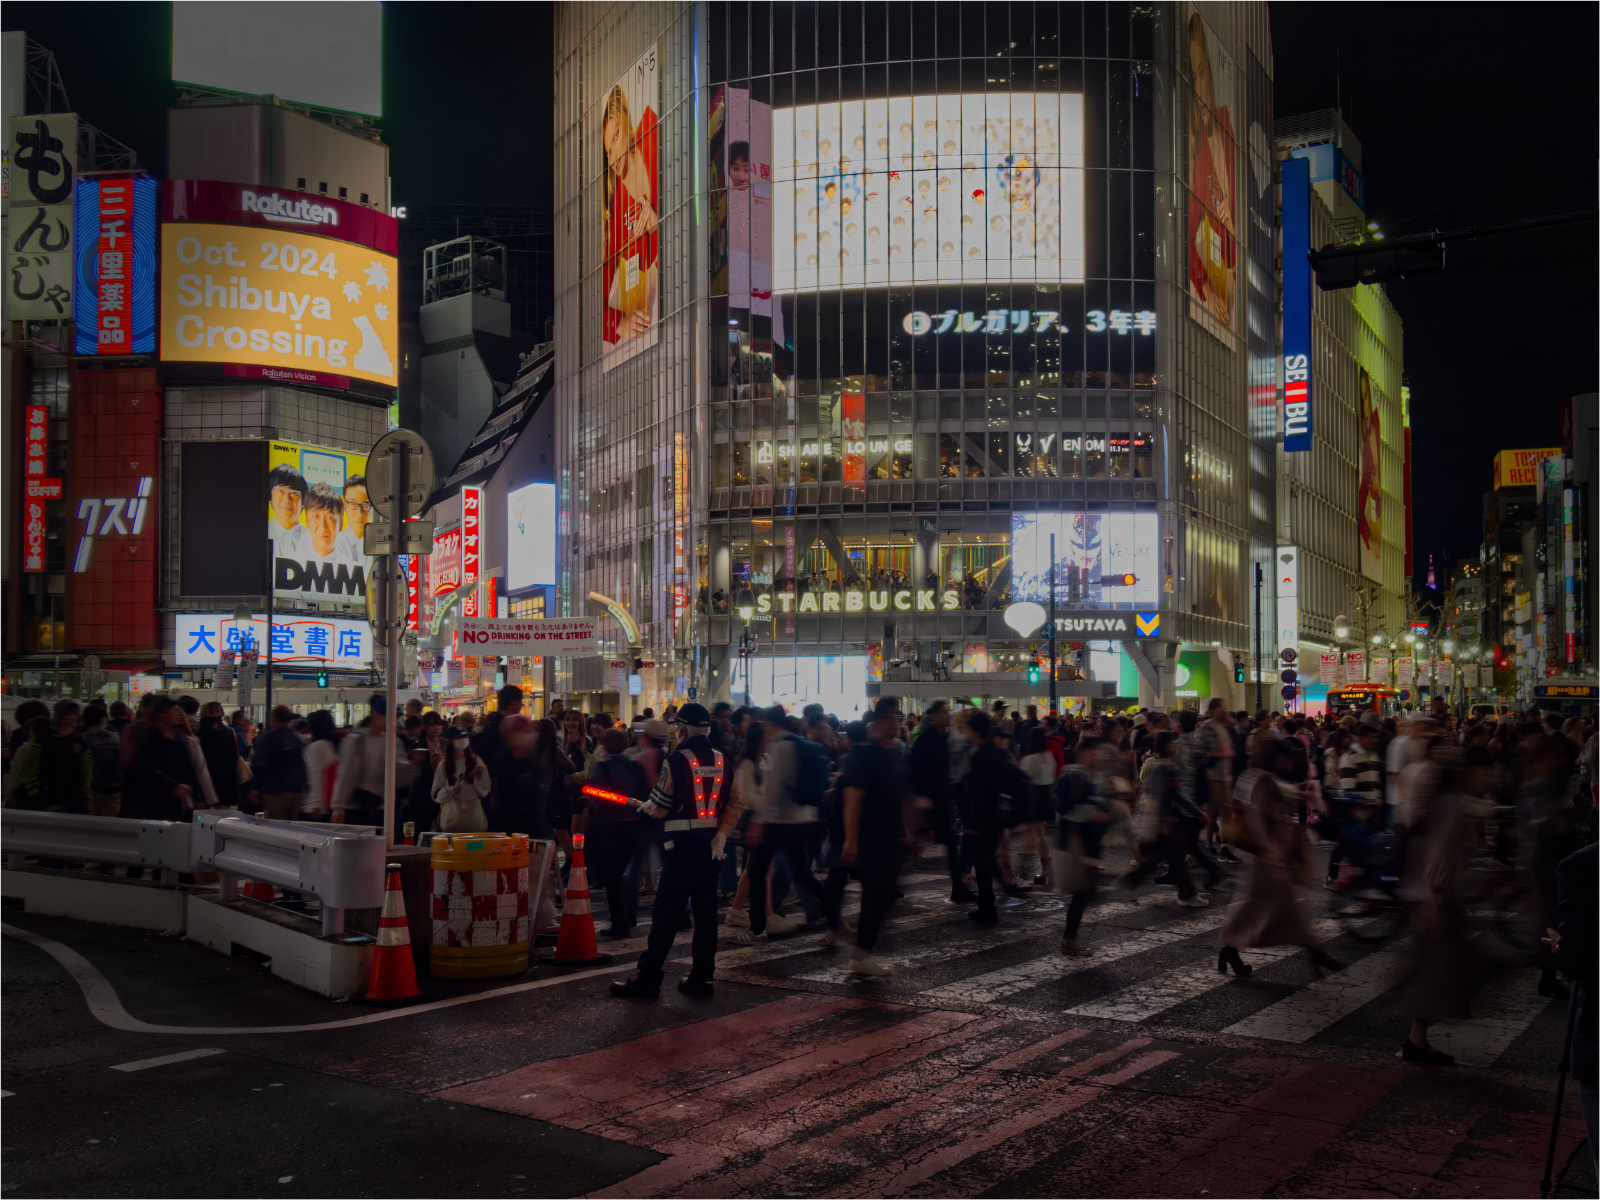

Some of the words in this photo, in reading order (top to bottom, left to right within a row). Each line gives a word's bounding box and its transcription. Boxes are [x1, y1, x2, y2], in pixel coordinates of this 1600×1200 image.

[14, 119, 73, 314] もんじゃ
[241, 190, 339, 226] Rakuten
[98, 186, 126, 344] 三千里薬品
[176, 236, 246, 268] Oct.
[260, 242, 338, 280] 2024
[176, 273, 332, 322] Shibuya
[175, 314, 348, 368] Crossing
[262, 368, 293, 379] Rakuten
[293, 372, 317, 382] Vision
[1285, 354, 1308, 437] SEIBU
[778, 442, 832, 458] SHARE
[848, 439, 913, 454] LOUNGE
[1039, 433, 1105, 454] VENOM
[433, 533, 460, 561] カラオケ
[465, 497, 477, 564] カラオケ
[275, 557, 367, 597] DMM
[757, 590, 960, 613] STARBUCKS
[188, 624, 362, 657] 大盛堂書店
[464, 630, 489, 644] NO
[492, 632, 530, 640] DRINKING
[534, 632, 546, 640] ON
[548, 632, 564, 640] THE
[566, 631, 594, 640] STREET.
[1055, 619, 1127, 631] TSUTAYA
[1321, 654, 1337, 662] NO
